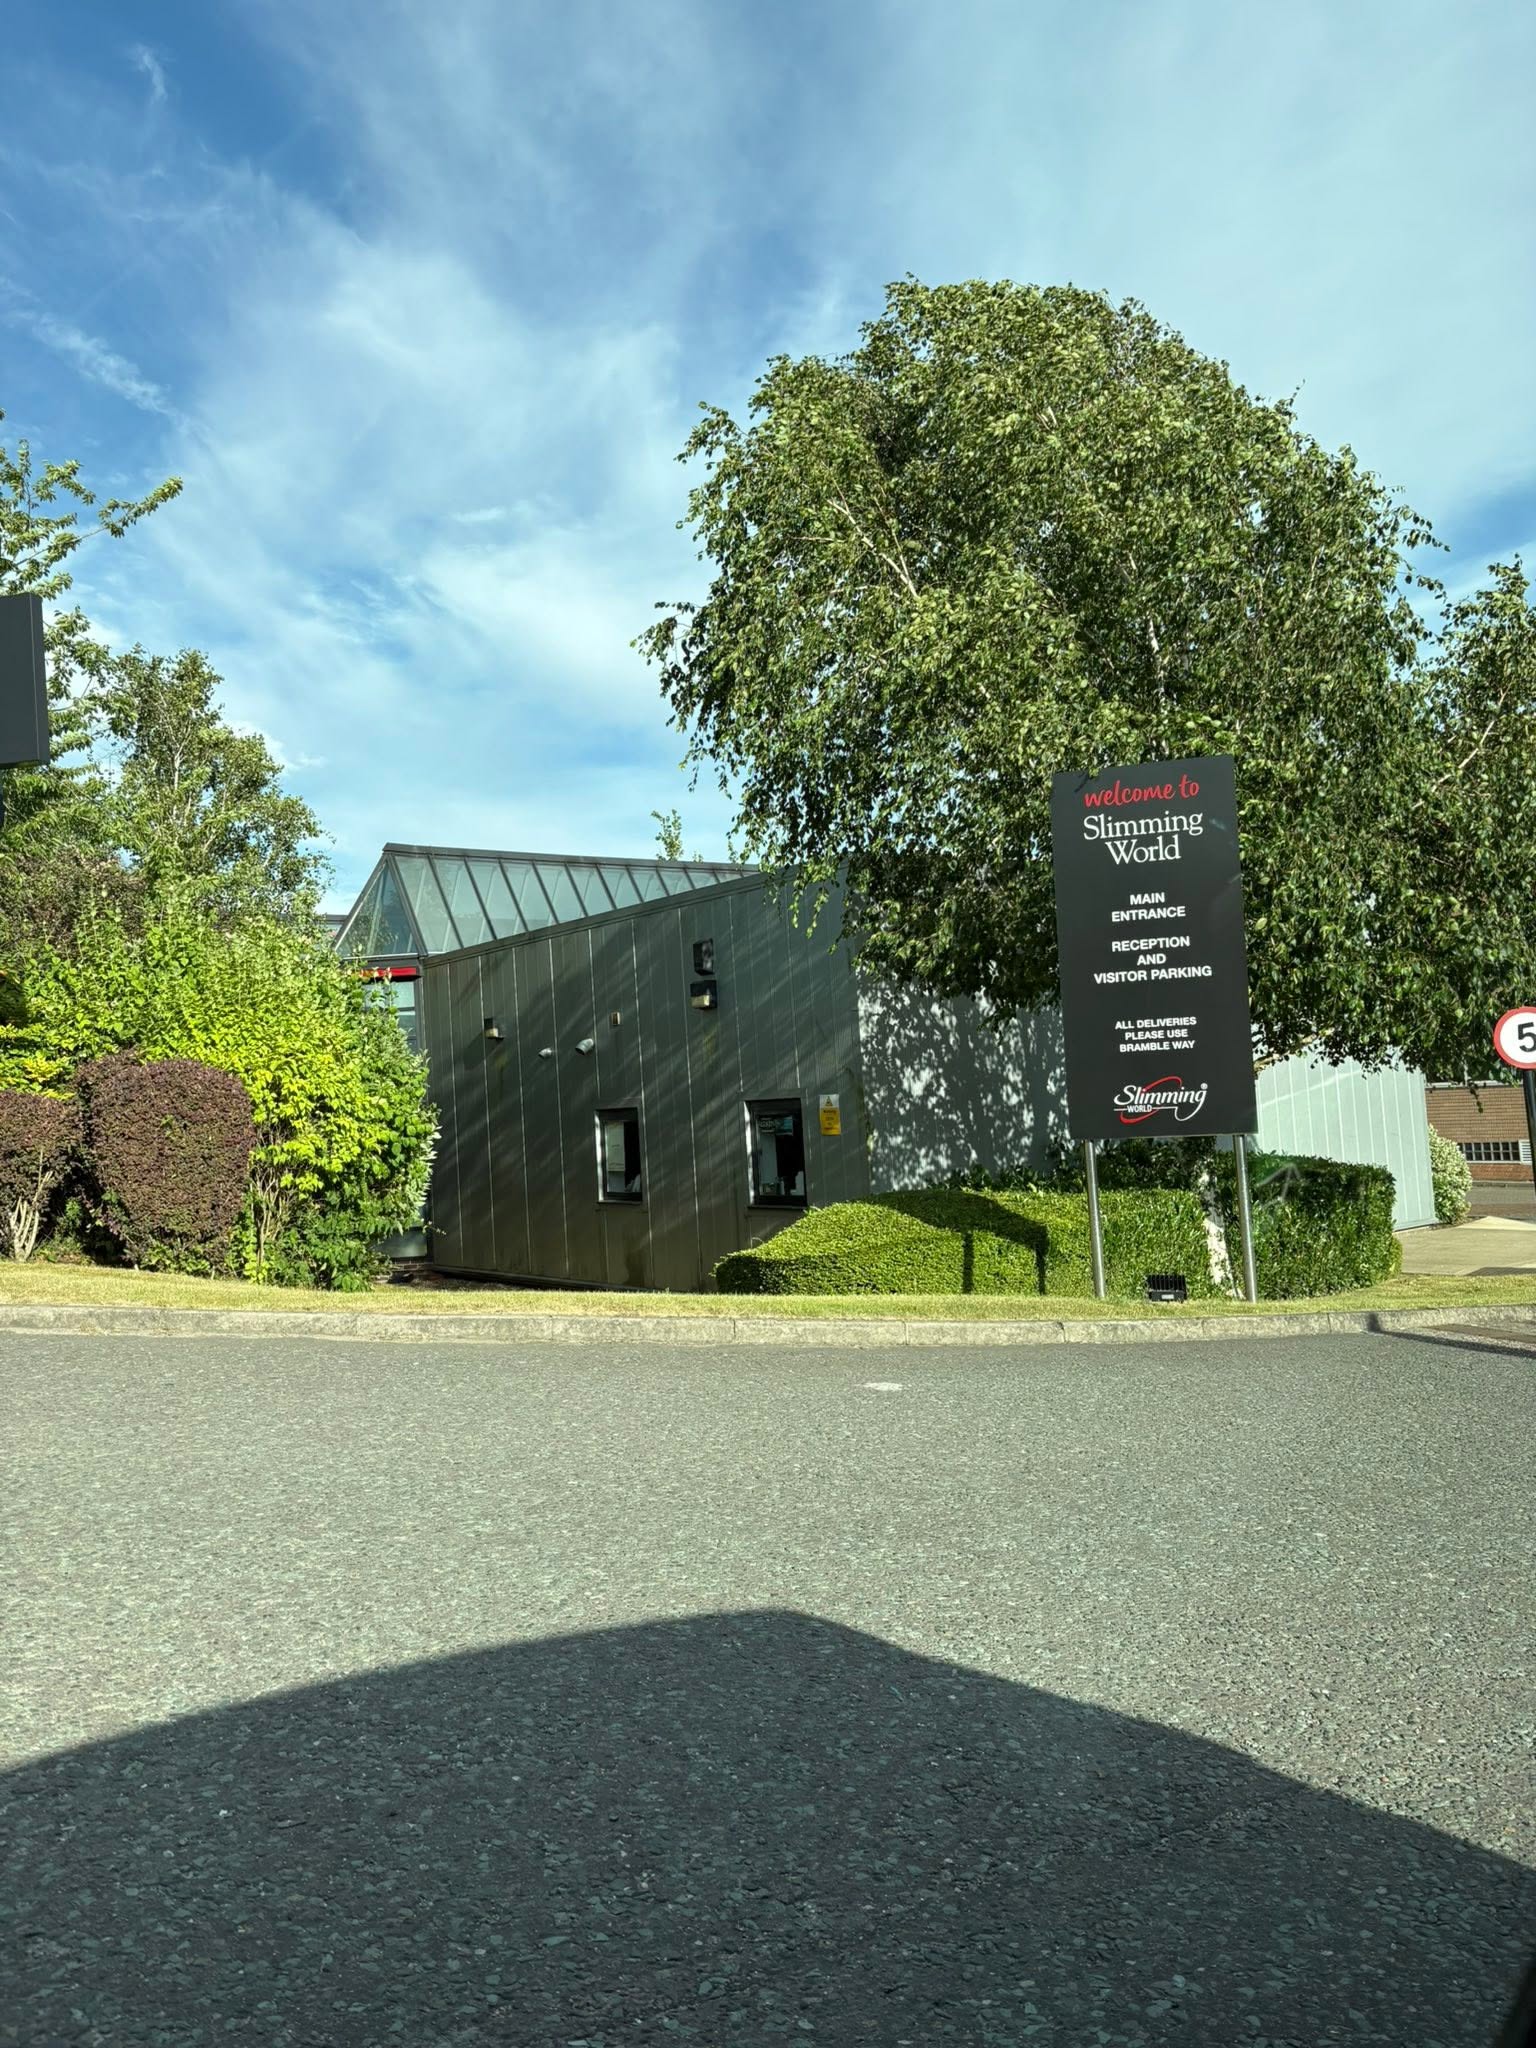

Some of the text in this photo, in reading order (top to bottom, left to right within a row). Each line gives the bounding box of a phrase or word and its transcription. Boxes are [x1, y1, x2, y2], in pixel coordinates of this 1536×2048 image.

[1083, 774, 1200, 807] welcome to
[1083, 810, 1204, 841] Slimming
[1105, 834, 1182, 865] World
[1129, 892, 1165, 905] MAIN
[1111, 906, 1186, 922] ENTRANCE
[1111, 936, 1190, 952] RECEPTION
[1136, 953, 1167, 966] AND
[1093, 965, 1213, 984] VISITOR PARKING
[1114, 1016, 1197, 1030] ALL DELIVERIES
[1124, 1029, 1189, 1041] PLEASE USE
[1517, 1021, 1536, 1053] 5
[1119, 1040, 1196, 1053] BRAMBLE WAY
[1113, 1084, 1208, 1121] Slimming
[1126, 1104, 1153, 1114] WORLD
